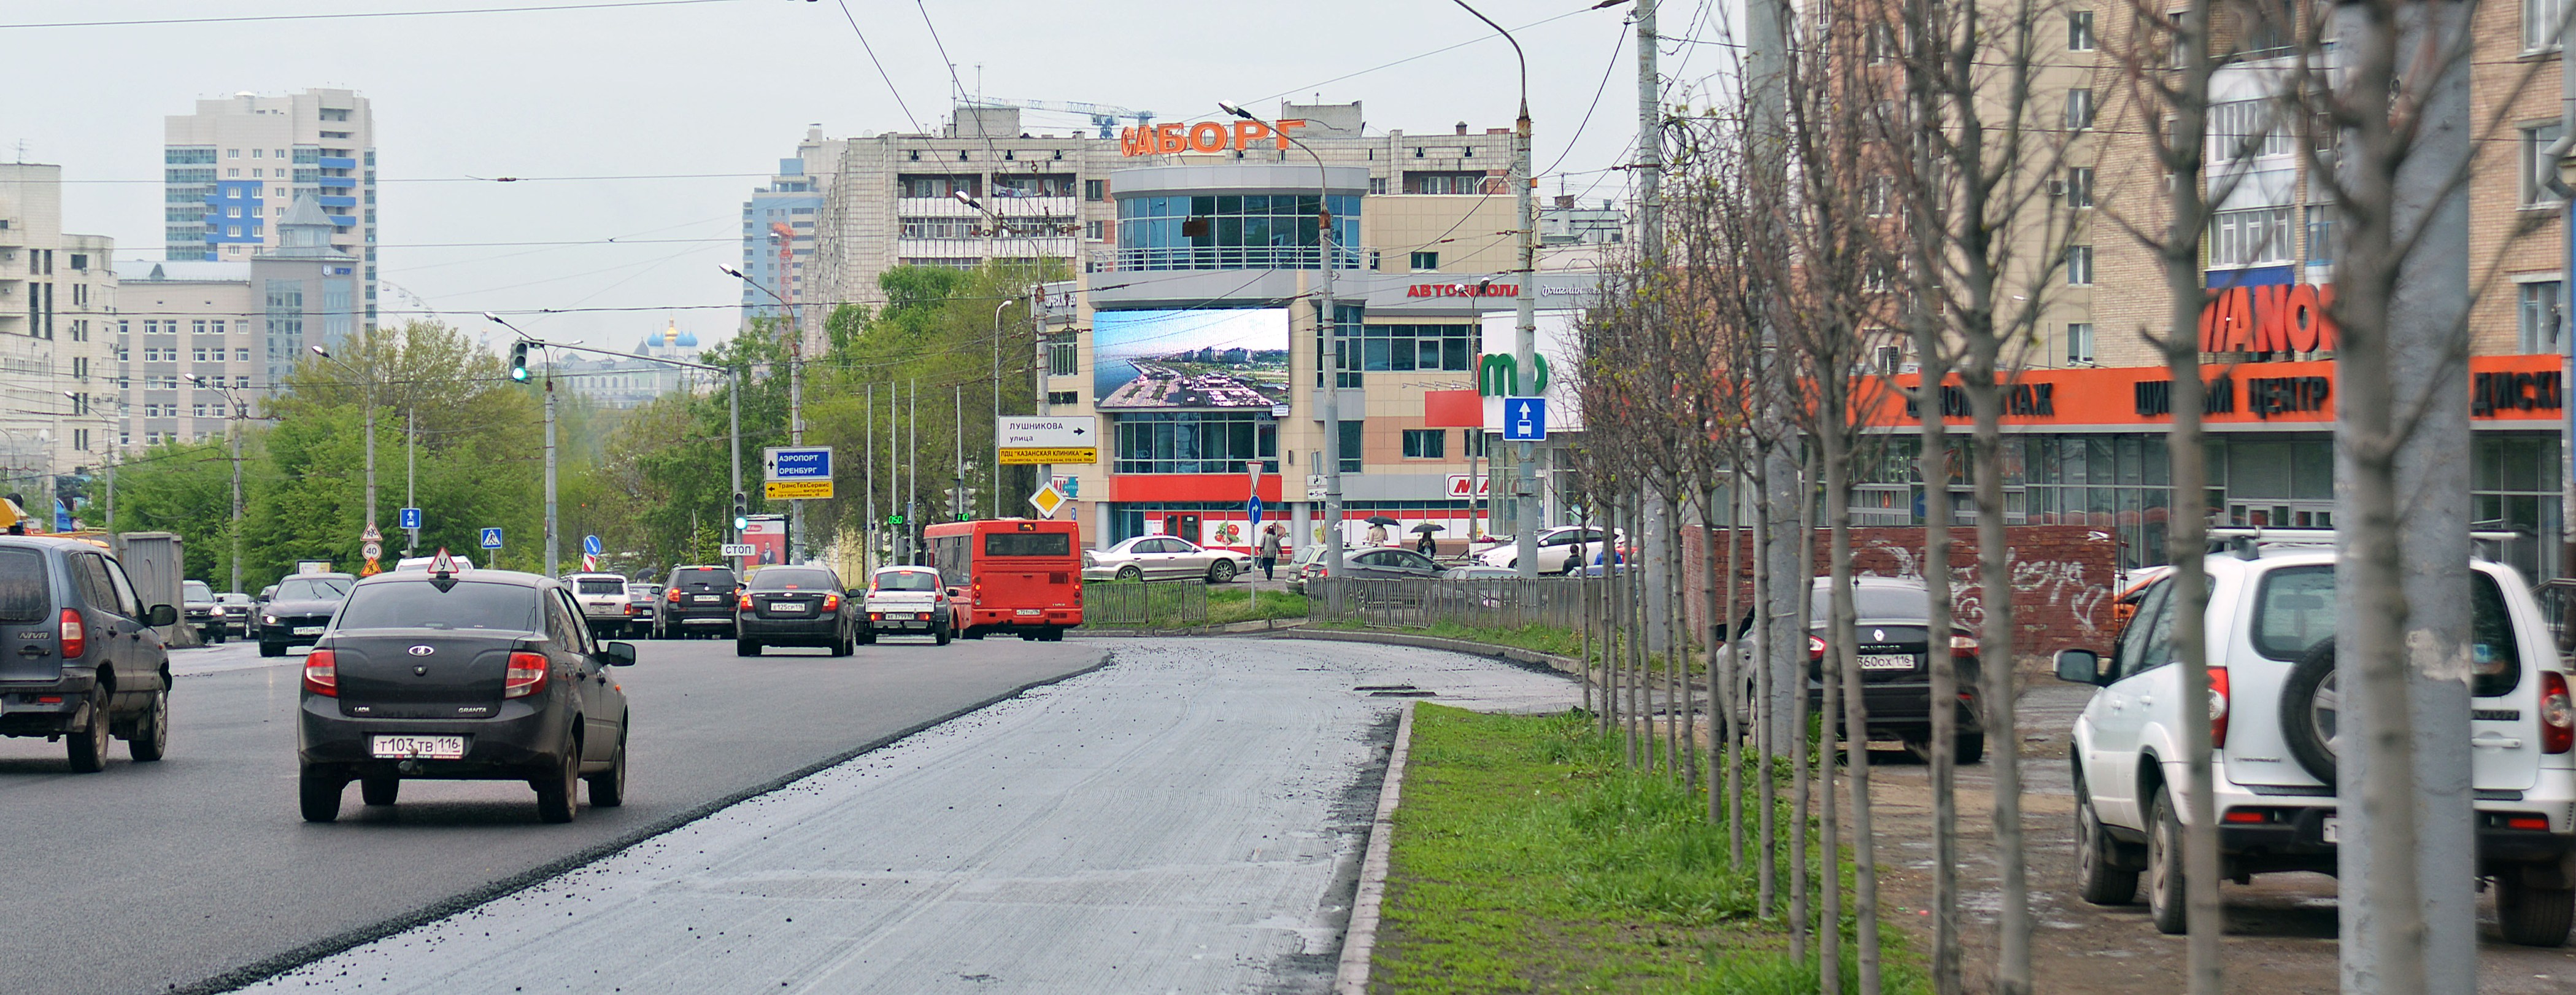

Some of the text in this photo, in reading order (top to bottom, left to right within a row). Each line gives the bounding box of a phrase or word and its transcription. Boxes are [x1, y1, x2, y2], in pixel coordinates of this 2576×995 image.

[1120, 120, 1306, 158] САБОРГ
[2248, 376, 2329, 420] ЦЕНТР
[725, 546, 751, 554] СТОП
[1894, 655, 1910, 664] 116
[438, 738, 458, 749] 116
